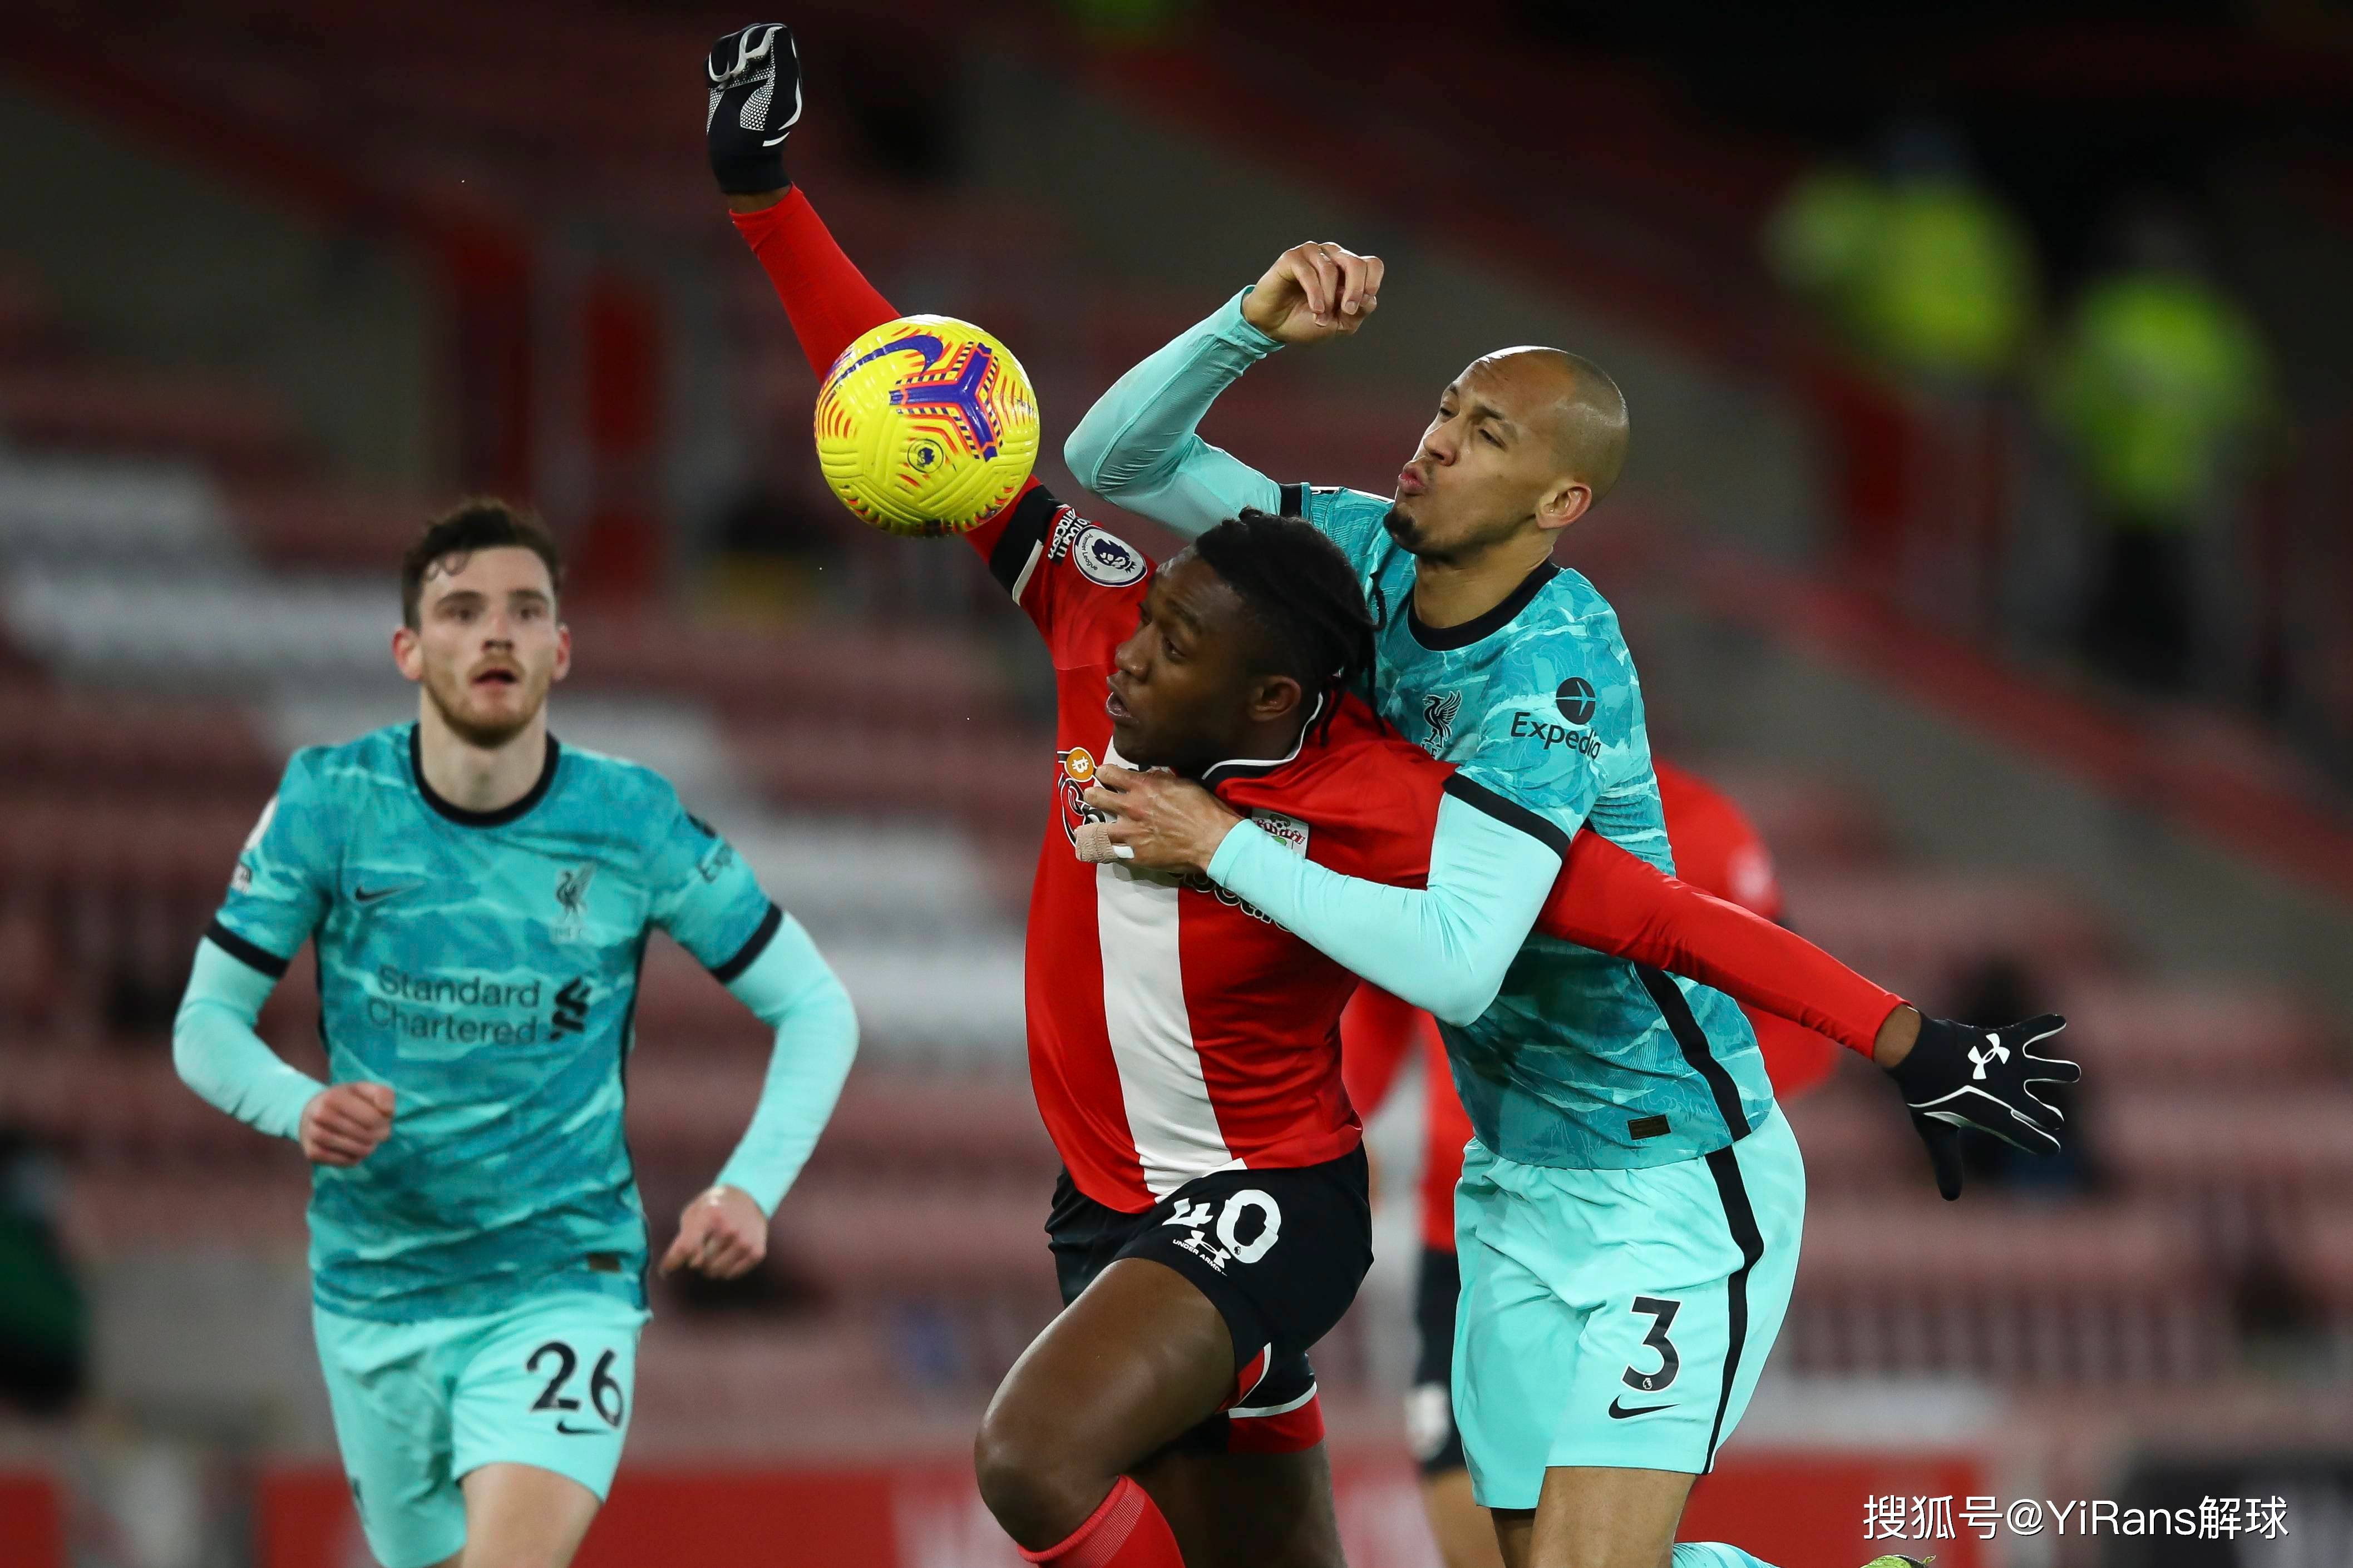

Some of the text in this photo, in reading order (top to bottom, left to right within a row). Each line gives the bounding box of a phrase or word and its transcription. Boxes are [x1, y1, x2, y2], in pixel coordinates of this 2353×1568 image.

[1082, 533, 1098, 571] Premier League
[1510, 711, 1602, 760] Expedia
[378, 964, 541, 1008] Standard
[368, 997, 537, 1045] Chartered
[1162, 1189, 1281, 1264] 40
[1172, 1239, 1199, 1255] UNDER
[1621, 1296, 1680, 1391] 3
[527, 1341, 624, 1428] 26
